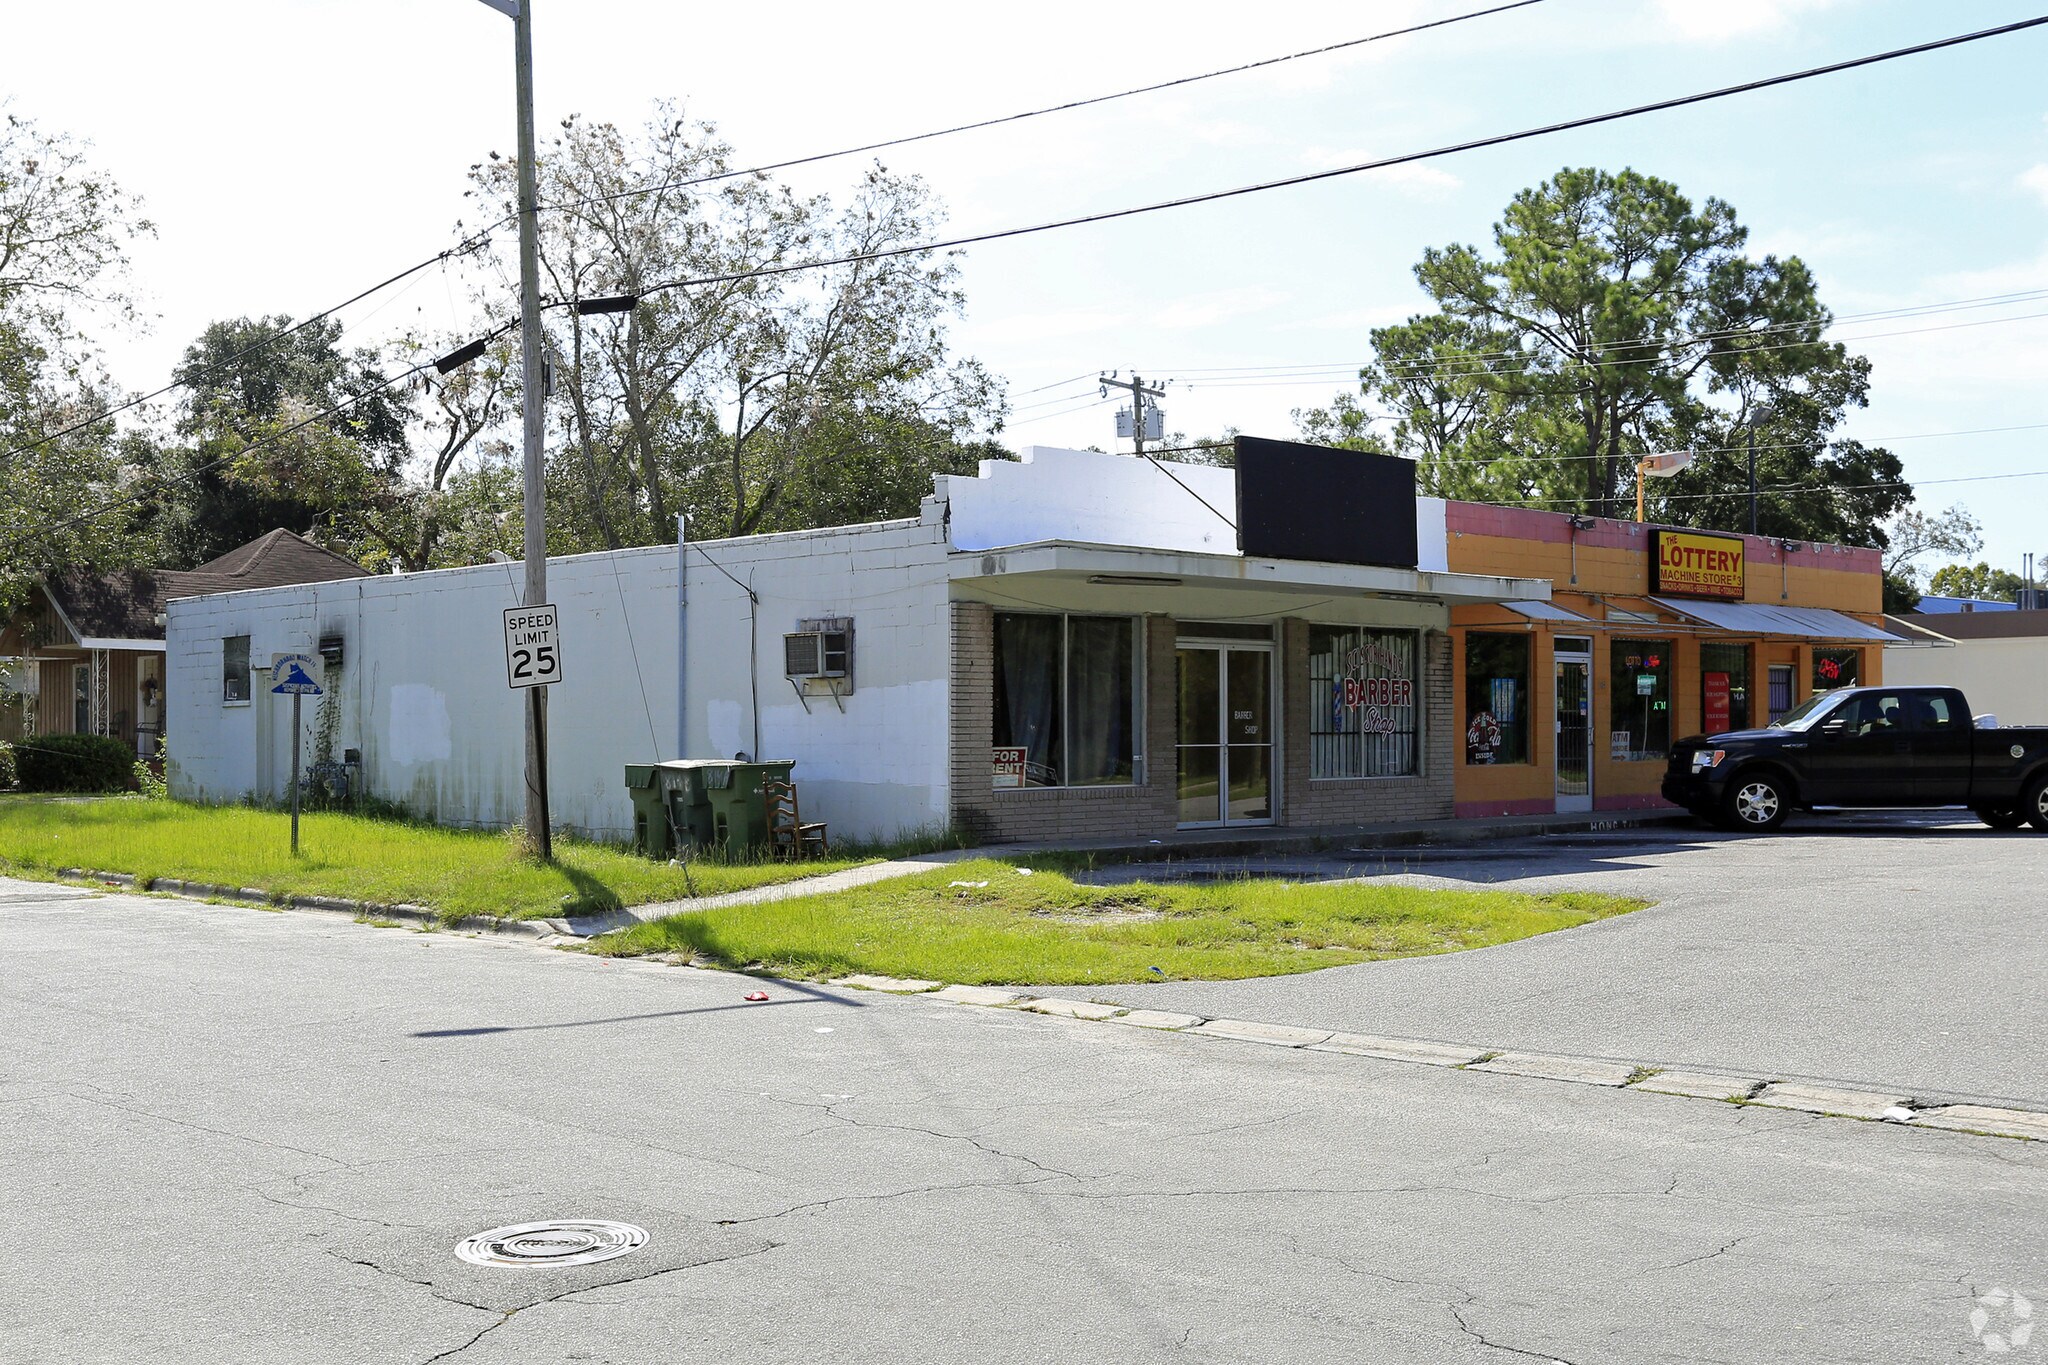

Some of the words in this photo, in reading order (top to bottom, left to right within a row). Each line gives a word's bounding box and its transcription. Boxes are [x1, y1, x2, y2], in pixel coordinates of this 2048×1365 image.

[1666, 535, 1678, 546] THE
[1660, 544, 1741, 573] LOTTERY
[1660, 569, 1700, 582] MACHINE
[1703, 573, 1732, 585] STORE
[509, 614, 553, 630] SPEED
[515, 631, 549, 645] LIMIT
[512, 646, 556, 678] 25
[1344, 677, 1412, 706] BARBER
[1363, 706, 1396, 741] Shop
[1612, 732, 1629, 743] ATM
[992, 751, 1019, 762] FOR
